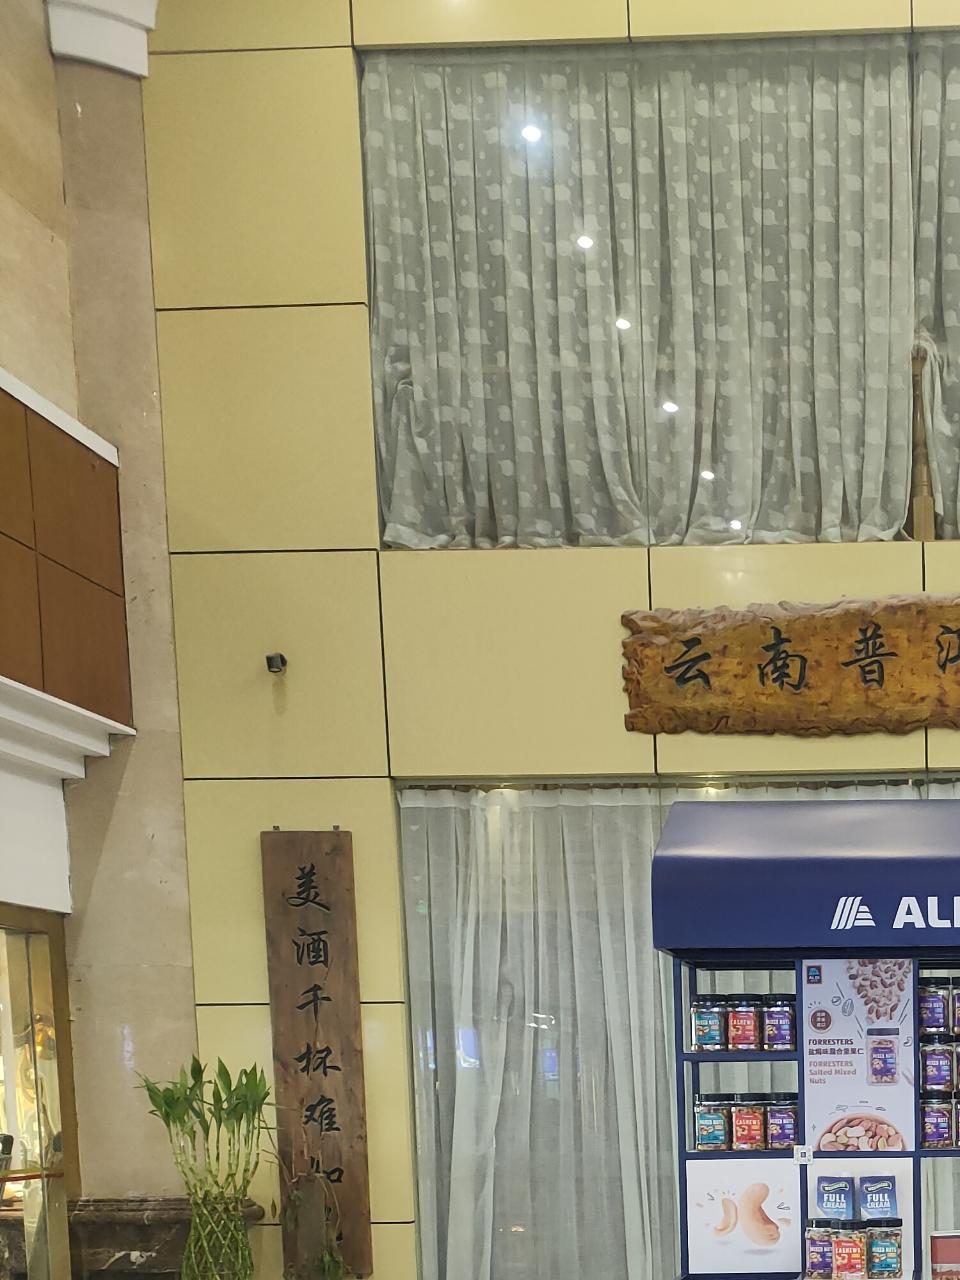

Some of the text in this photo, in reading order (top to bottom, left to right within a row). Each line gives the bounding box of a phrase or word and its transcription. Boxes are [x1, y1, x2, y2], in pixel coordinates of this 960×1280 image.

[808, 1038, 854, 1046] FORRESTERS
[809, 1068, 857, 1076] Salted Mixed
[824, 1194, 846, 1202] FULL
[867, 1193, 889, 1202] FULL
